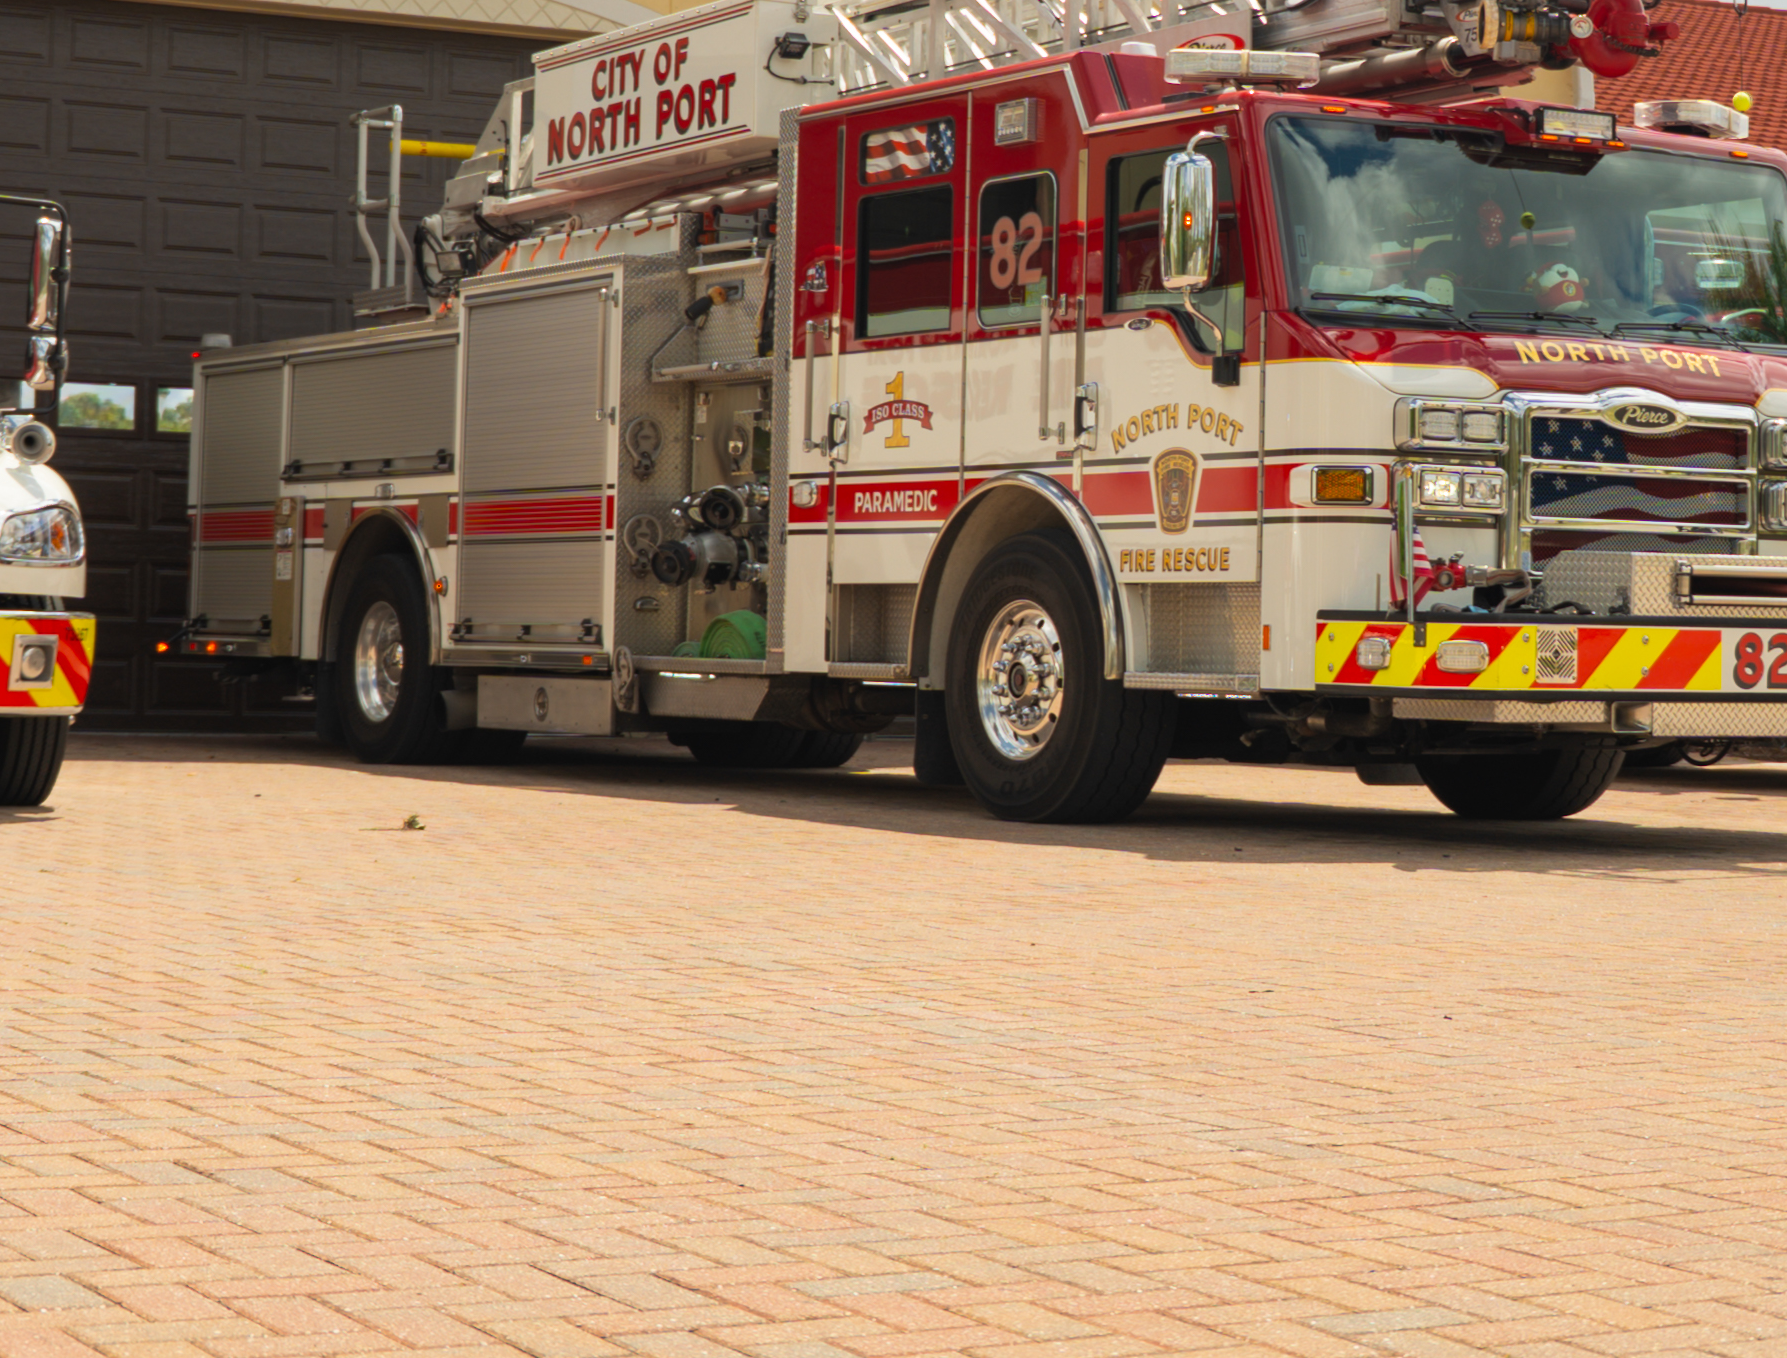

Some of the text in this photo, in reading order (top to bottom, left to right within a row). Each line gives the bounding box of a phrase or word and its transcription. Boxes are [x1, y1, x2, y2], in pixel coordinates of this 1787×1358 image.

[1464, 26, 1478, 43] 75
[591, 37, 689, 102] CITY OF
[547, 72, 736, 166] NORTH PORT
[990, 211, 1043, 290] 82
[1514, 340, 1721, 377] NORTH PORT
[872, 403, 924, 422] ISO CLASS
[884, 371, 910, 448] 1
[1622, 405, 1668, 424] Pierce
[1111, 403, 1244, 454] NORTH PORT
[854, 489, 938, 514] PARAMEDIC
[1120, 547, 1230, 572] FIRE RESCUE
